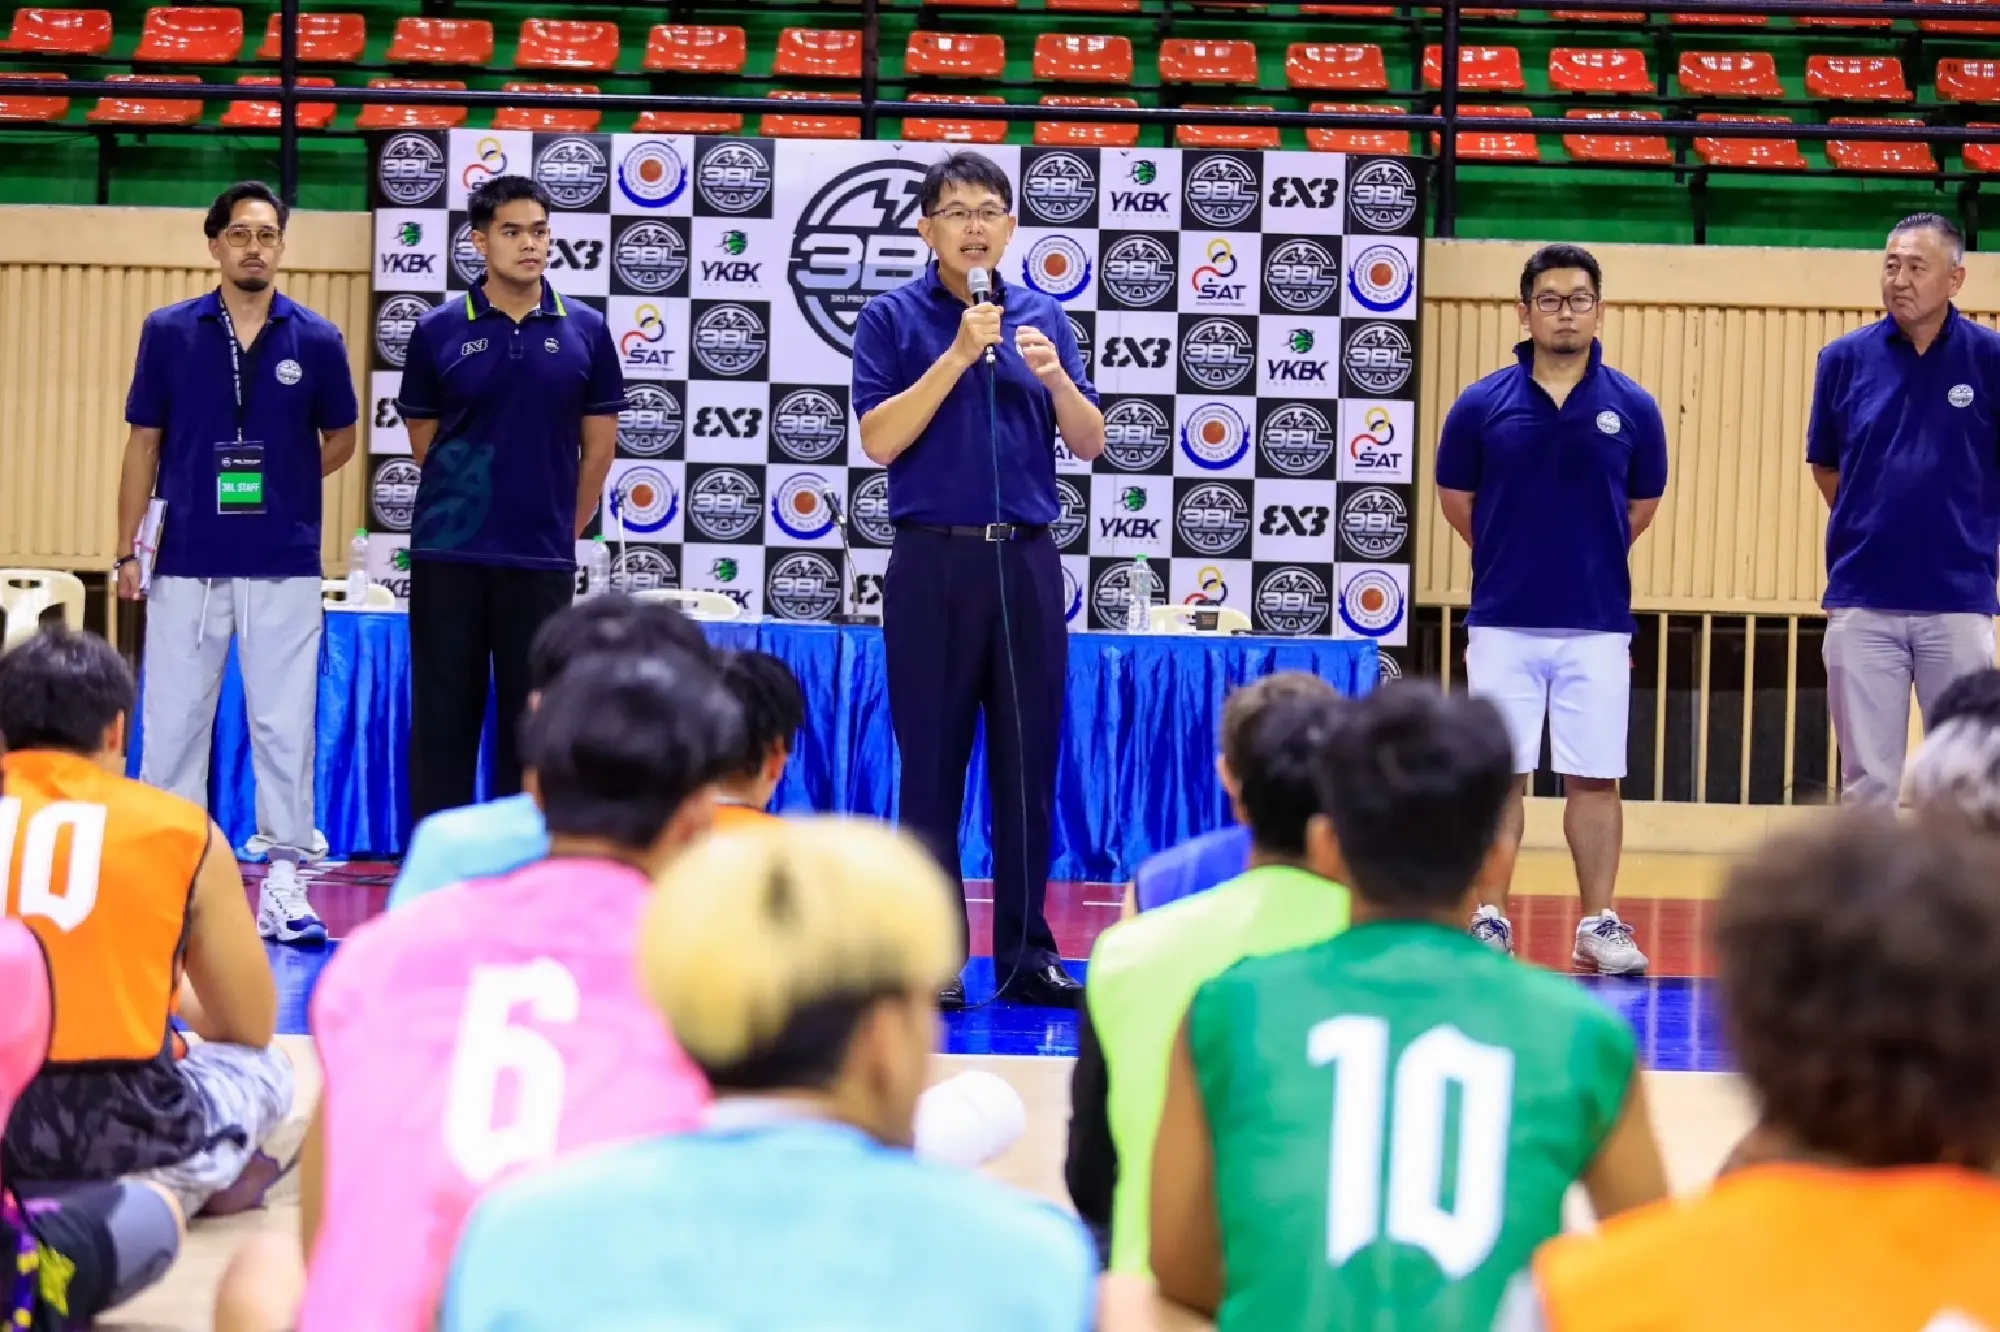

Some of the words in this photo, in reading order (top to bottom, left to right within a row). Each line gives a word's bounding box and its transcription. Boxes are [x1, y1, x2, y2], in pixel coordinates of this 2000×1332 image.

[383, 159, 444, 180] 3BL
[540, 163, 606, 183] 3BL
[702, 167, 768, 188] 3BL
[1029, 176, 1095, 197] 3BL
[1190, 180, 1258, 201] 3BL
[1353, 184, 1415, 205] 3BL
[1110, 191, 1172, 212] YKBK
[381, 254, 437, 273] YKBK
[617, 244, 686, 265] 3BL
[796, 233, 930, 290] 3B
[701, 261, 763, 282] YKBK
[1107, 260, 1175, 282] 3BL
[1269, 265, 1337, 286] 3BL
[1196, 284, 1247, 300] SAT
[697, 330, 765, 351] 3BL
[625, 349, 676, 365] SAT
[1186, 344, 1253, 365] 3BL
[1348, 350, 1411, 371] 3BL
[1267, 359, 1330, 381] YKBK
[777, 415, 844, 435] 3BL
[1265, 428, 1332, 449] 3BL
[1355, 452, 1403, 468] SAT
[693, 494, 759, 514] 3BL
[1100, 518, 1161, 539] YKBK
[1181, 509, 1248, 532] 3BL
[1344, 513, 1407, 535] 3BL
[772, 578, 840, 597] 3BL
[1261, 591, 1328, 612] 3BL
[0, 797, 107, 932] 10
[443, 956, 580, 1183] 6
[1307, 1013, 1514, 1280] 10
